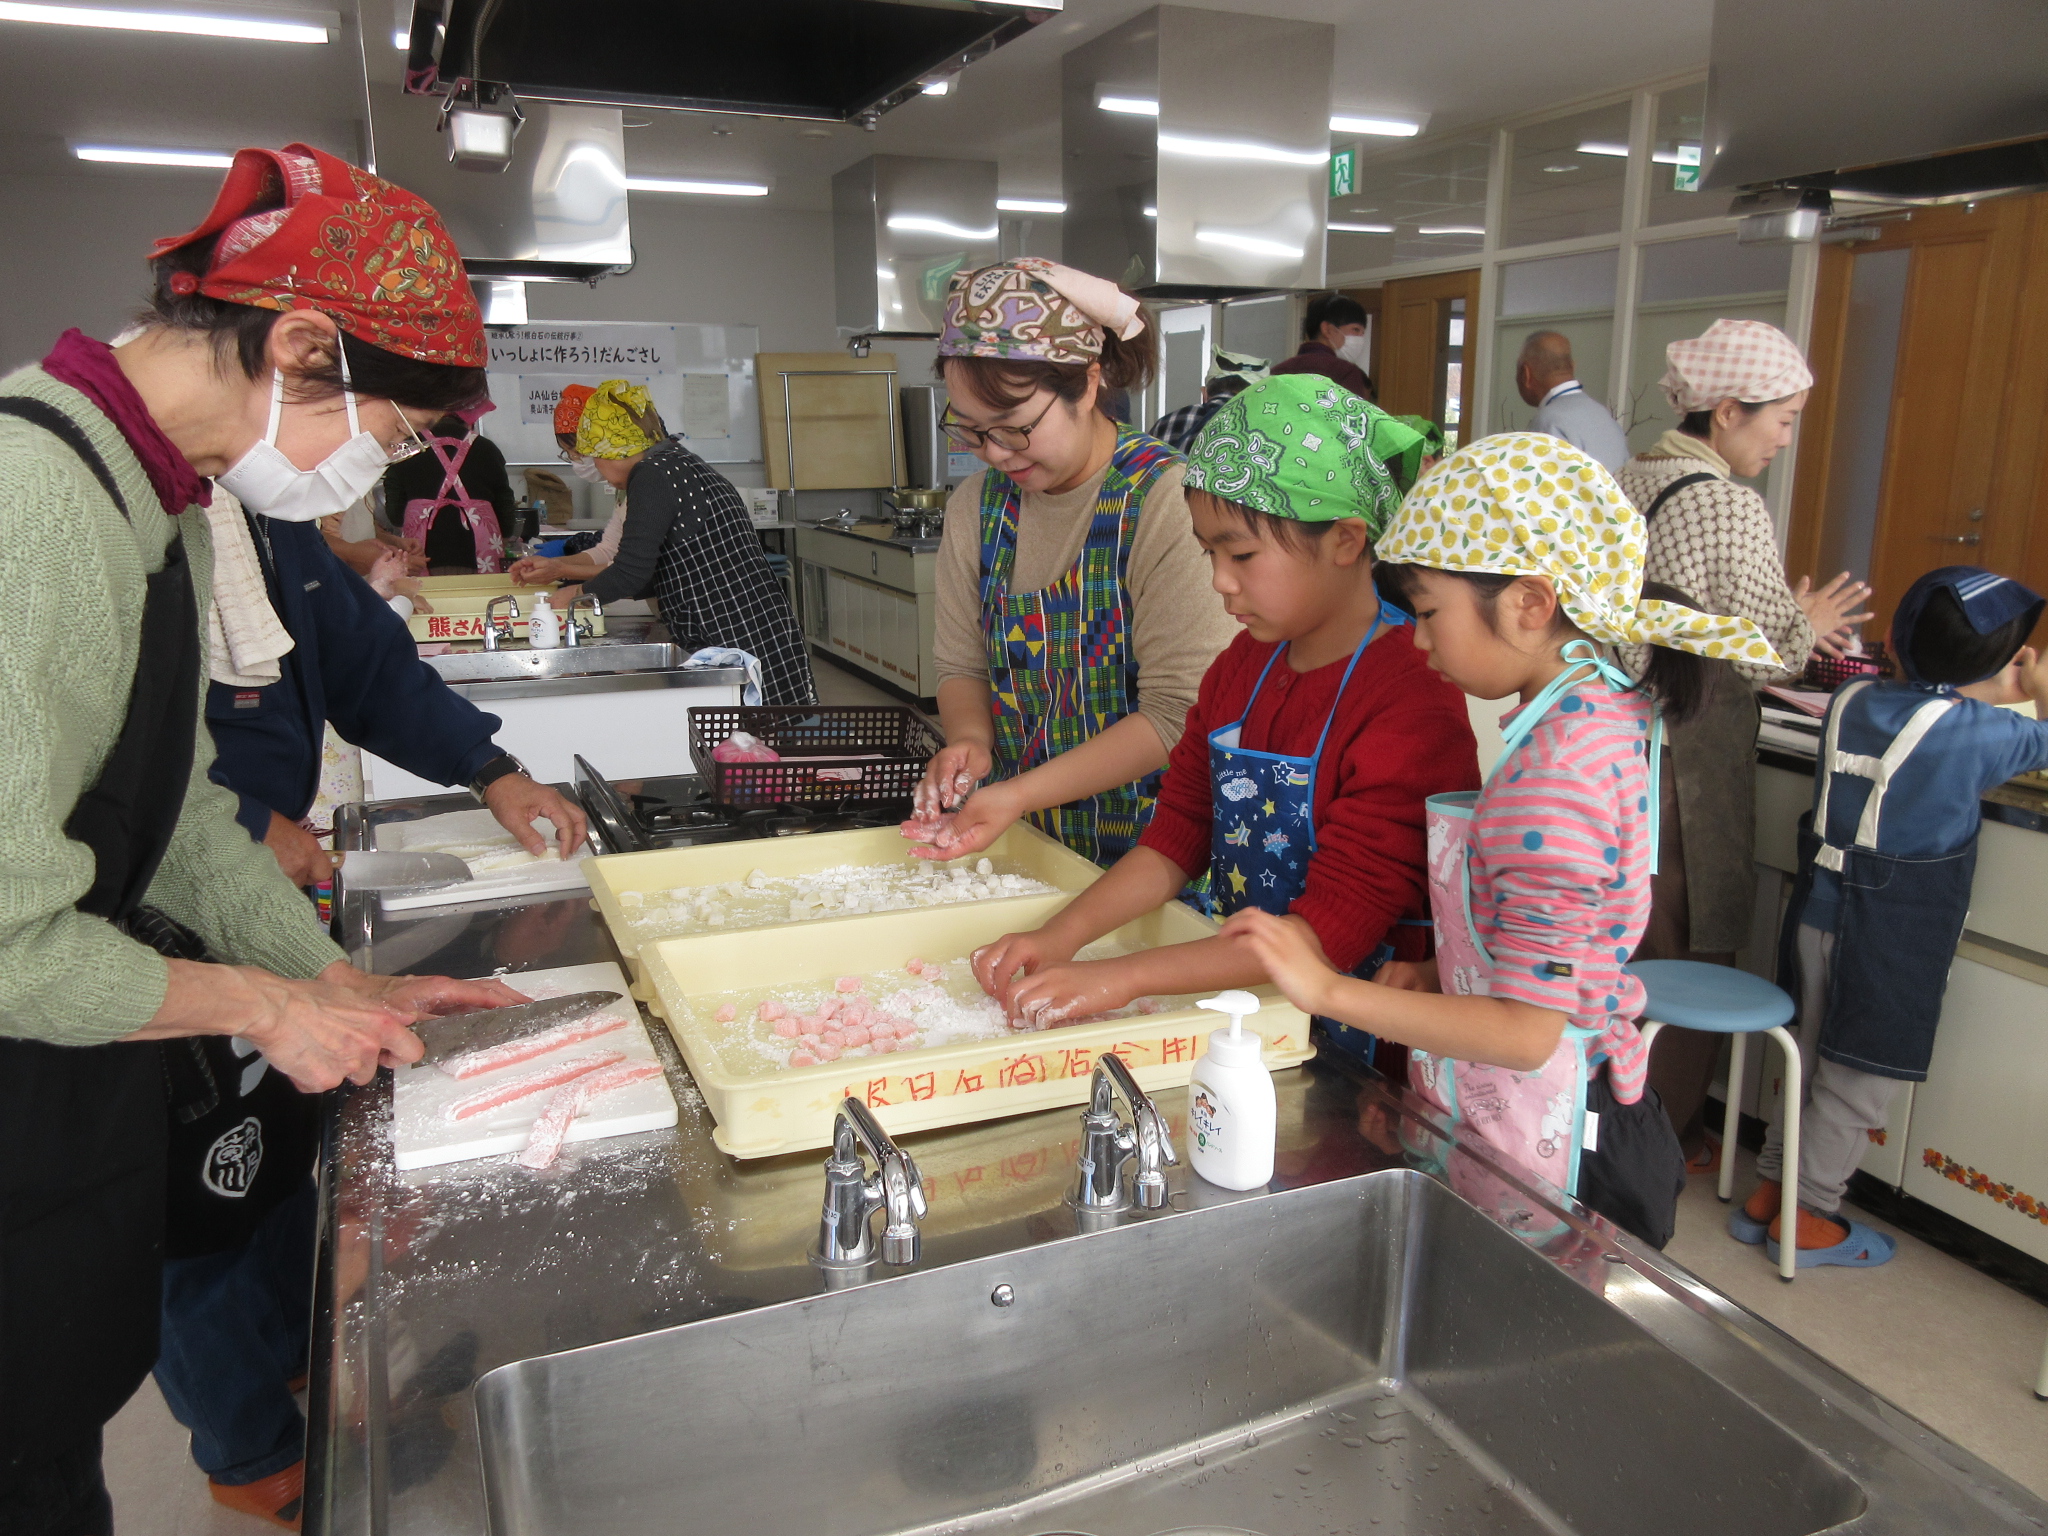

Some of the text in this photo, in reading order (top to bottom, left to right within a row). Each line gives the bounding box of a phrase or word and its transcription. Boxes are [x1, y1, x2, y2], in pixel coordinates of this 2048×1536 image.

[1235, 768, 1248, 777] me
[1190, 1107, 1222, 1136] キレイキレイ
